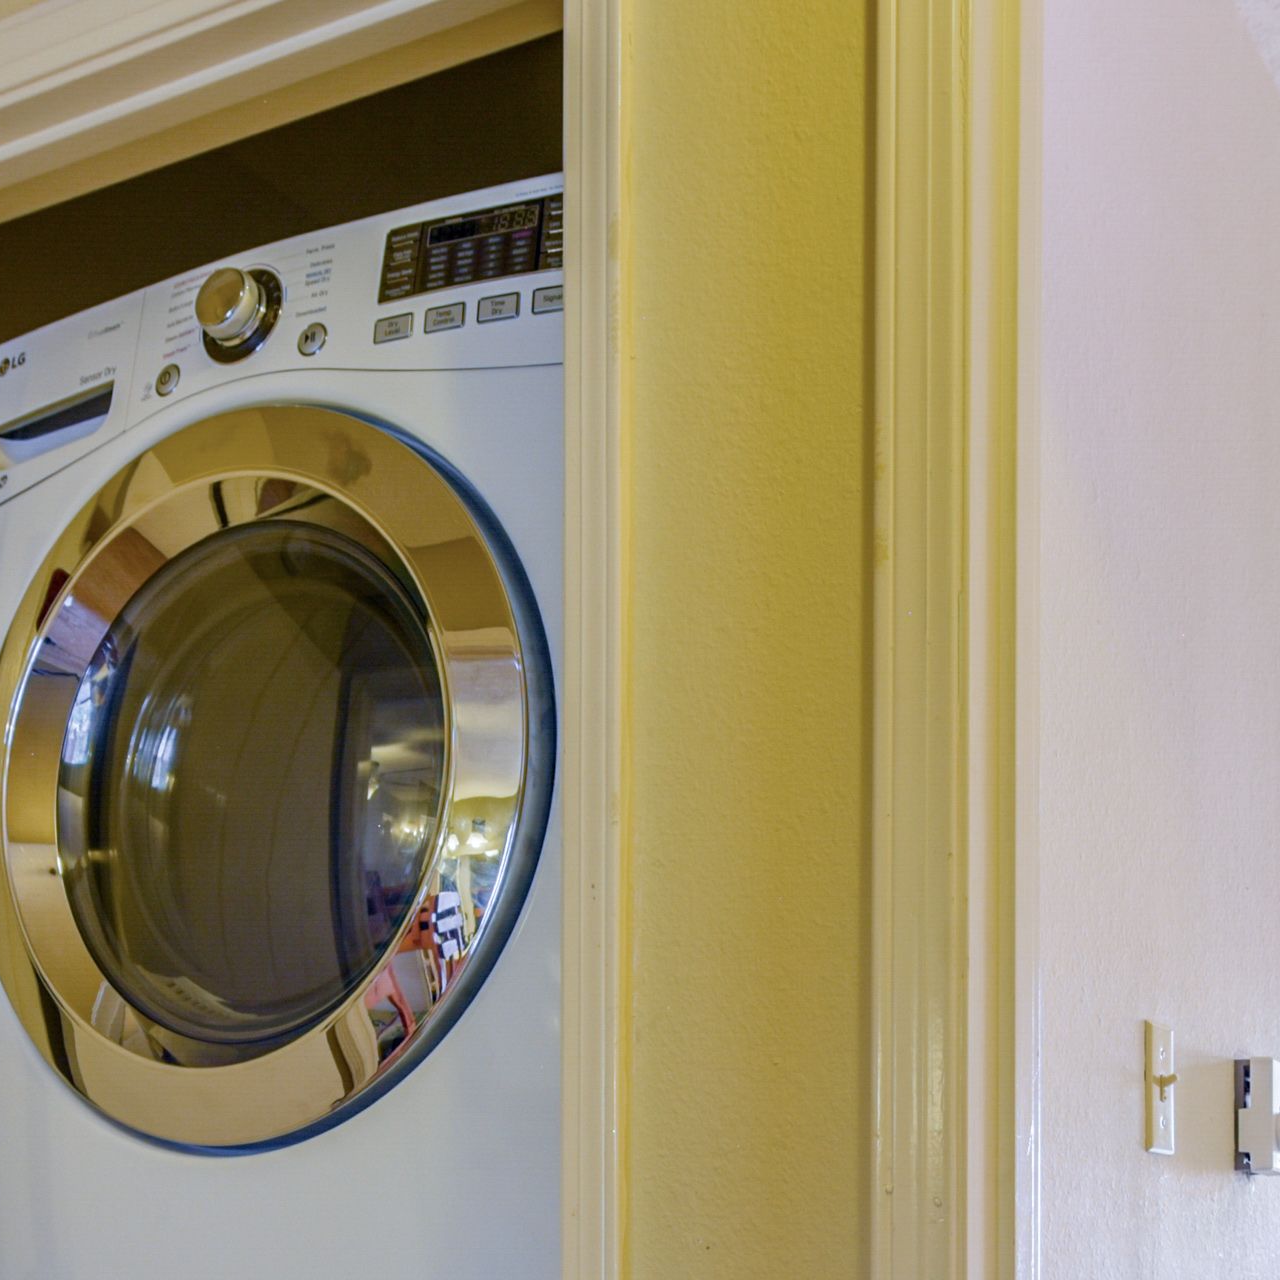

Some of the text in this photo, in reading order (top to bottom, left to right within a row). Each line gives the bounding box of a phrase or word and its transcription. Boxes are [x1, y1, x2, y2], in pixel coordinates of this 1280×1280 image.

[10, 351, 26, 369] LG
[79, 366, 118, 386] Sensor Dry
